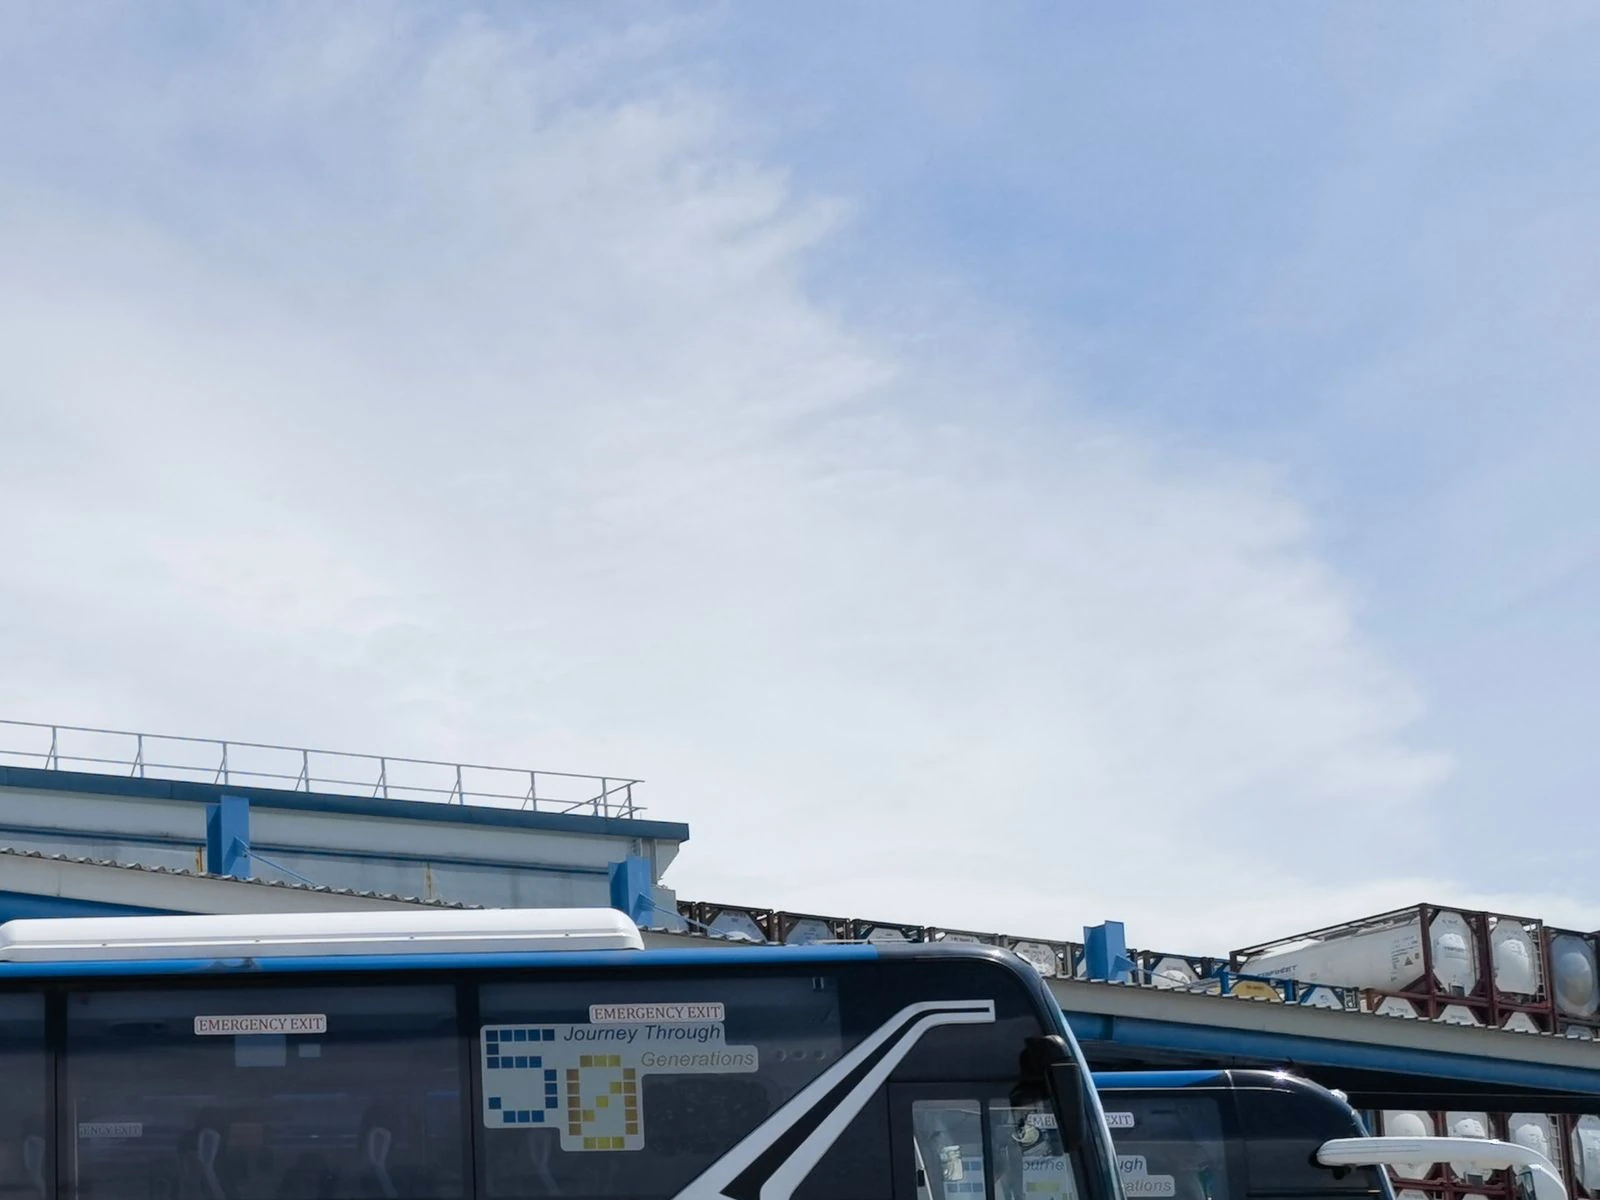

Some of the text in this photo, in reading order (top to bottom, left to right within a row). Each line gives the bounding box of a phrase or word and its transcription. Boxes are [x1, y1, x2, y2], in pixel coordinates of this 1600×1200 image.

[594, 1004, 721, 1021] EMERGENCY EXIT
[200, 1016, 323, 1032] EMERGENCY EXIT
[563, 1024, 720, 1043] Journey Through
[640, 1051, 754, 1067] Generations
